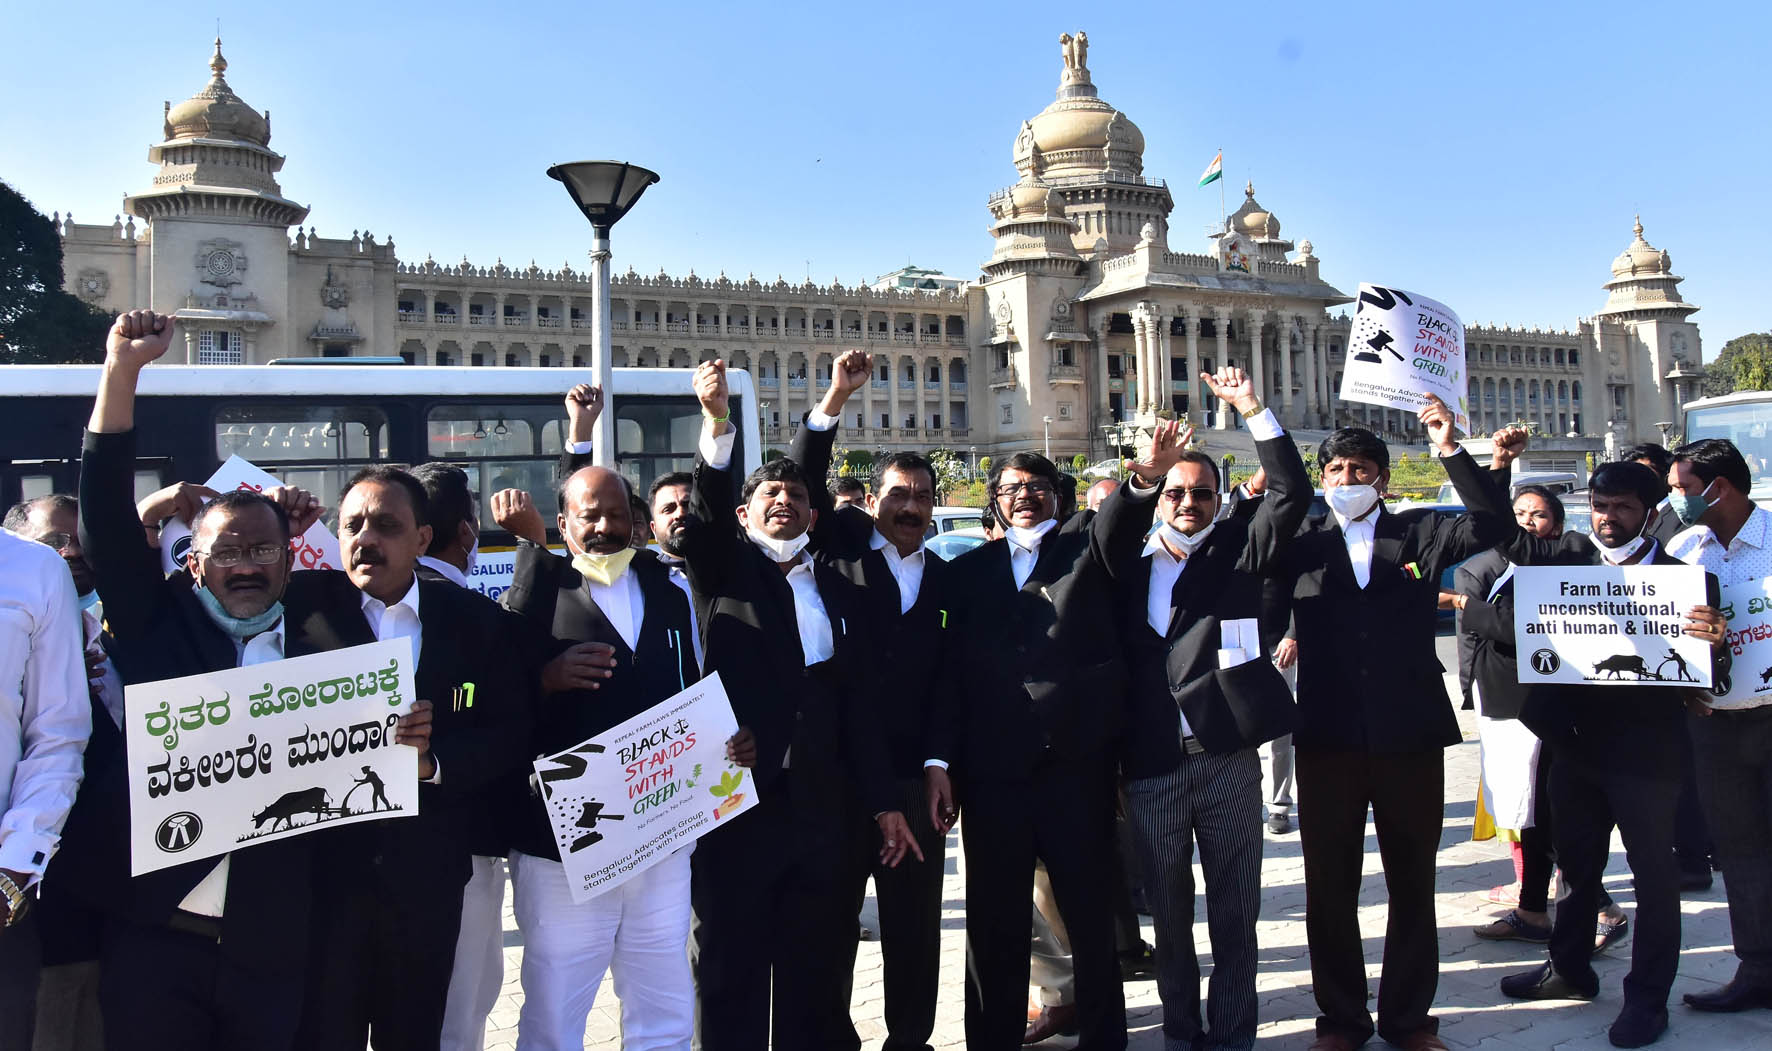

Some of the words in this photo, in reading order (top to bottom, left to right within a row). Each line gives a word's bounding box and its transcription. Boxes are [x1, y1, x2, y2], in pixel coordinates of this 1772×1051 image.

[1417, 313, 1452, 335] BLACK
[1414, 342, 1447, 362] WITH
[1416, 328, 1460, 356] STANDS
[1413, 357, 1448, 377] GREEN
[1351, 388, 1378, 398] stands
[1381, 391, 1414, 405] together
[1416, 398, 1433, 408] with
[1354, 381, 1396, 394] Bengaluru
[472, 563, 515, 576] GALUR
[1560, 582, 1600, 597] Farm
[1607, 582, 1636, 597] law
[1642, 581, 1656, 597] is
[1538, 601, 1681, 618] unconstitutional,
[1526, 621, 1557, 635] anti
[1563, 621, 1618, 635] human
[1624, 621, 1637, 635] &
[1643, 620, 1691, 638] illeg
[145, 690, 231, 751] ರೈತರ
[248, 658, 402, 719] ಹೋರಾಟಕ್ಕೆ
[614, 731, 635, 744] REPEAL
[636, 720, 653, 734] FARM
[653, 712, 670, 726] LAWS
[616, 726, 673, 765] BLACK
[625, 732, 697, 782] STANDS
[147, 733, 272, 799] ವಕೀಲರೇ
[629, 764, 673, 800] WITH
[633, 779, 681, 815] GREEN
[583, 871, 617, 891] stands
[618, 849, 655, 875] together
[656, 836, 674, 852] with
[674, 817, 709, 840] Farmers
[584, 853, 633, 882] Bengaluru
[634, 825, 677, 856] Advocates
[678, 810, 705, 830] Group
